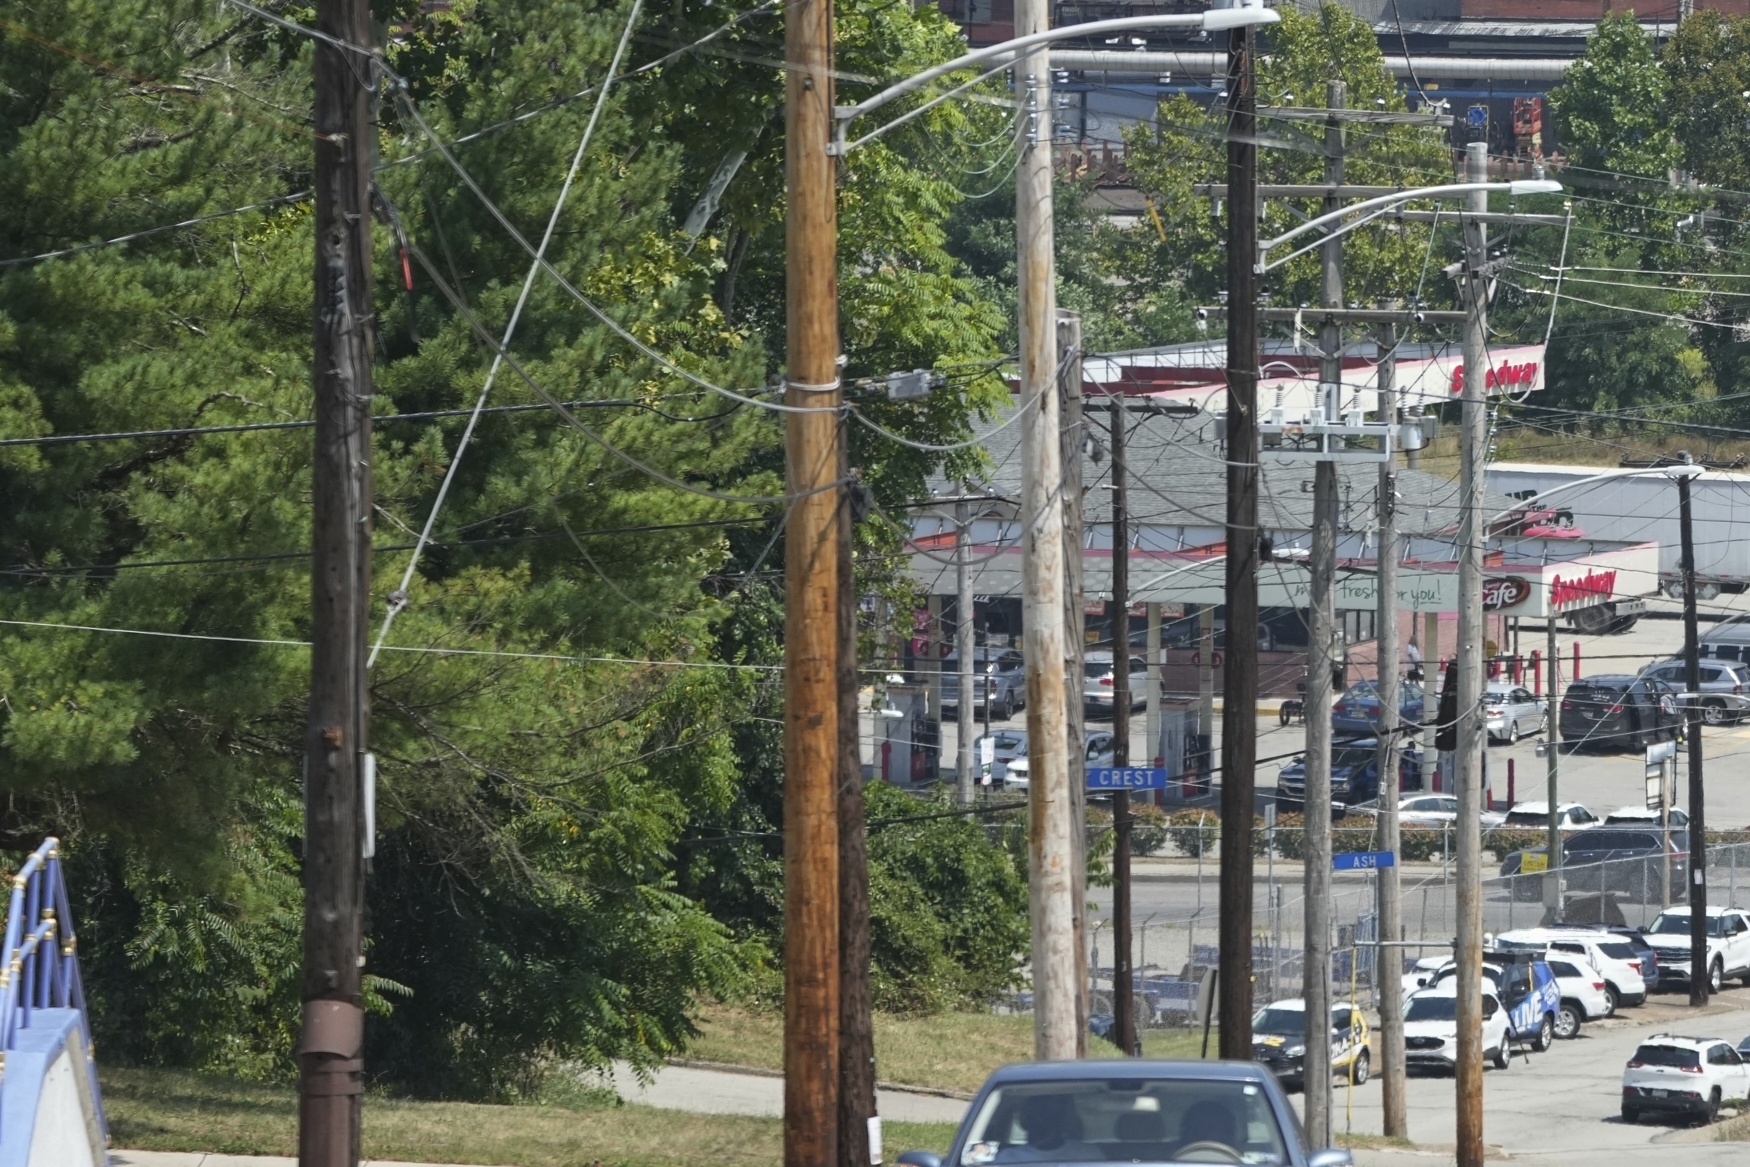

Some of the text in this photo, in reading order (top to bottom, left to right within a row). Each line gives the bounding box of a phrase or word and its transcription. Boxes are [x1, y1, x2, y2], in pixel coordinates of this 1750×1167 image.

[1451, 360, 1538, 392] Sedway
[1340, 579, 1378, 600] fresh
[1411, 579, 1441, 609] you!
[1551, 567, 1617, 611] Speedway
[1099, 770, 1154, 785] CREST
[1353, 855, 1377, 868] ASH
